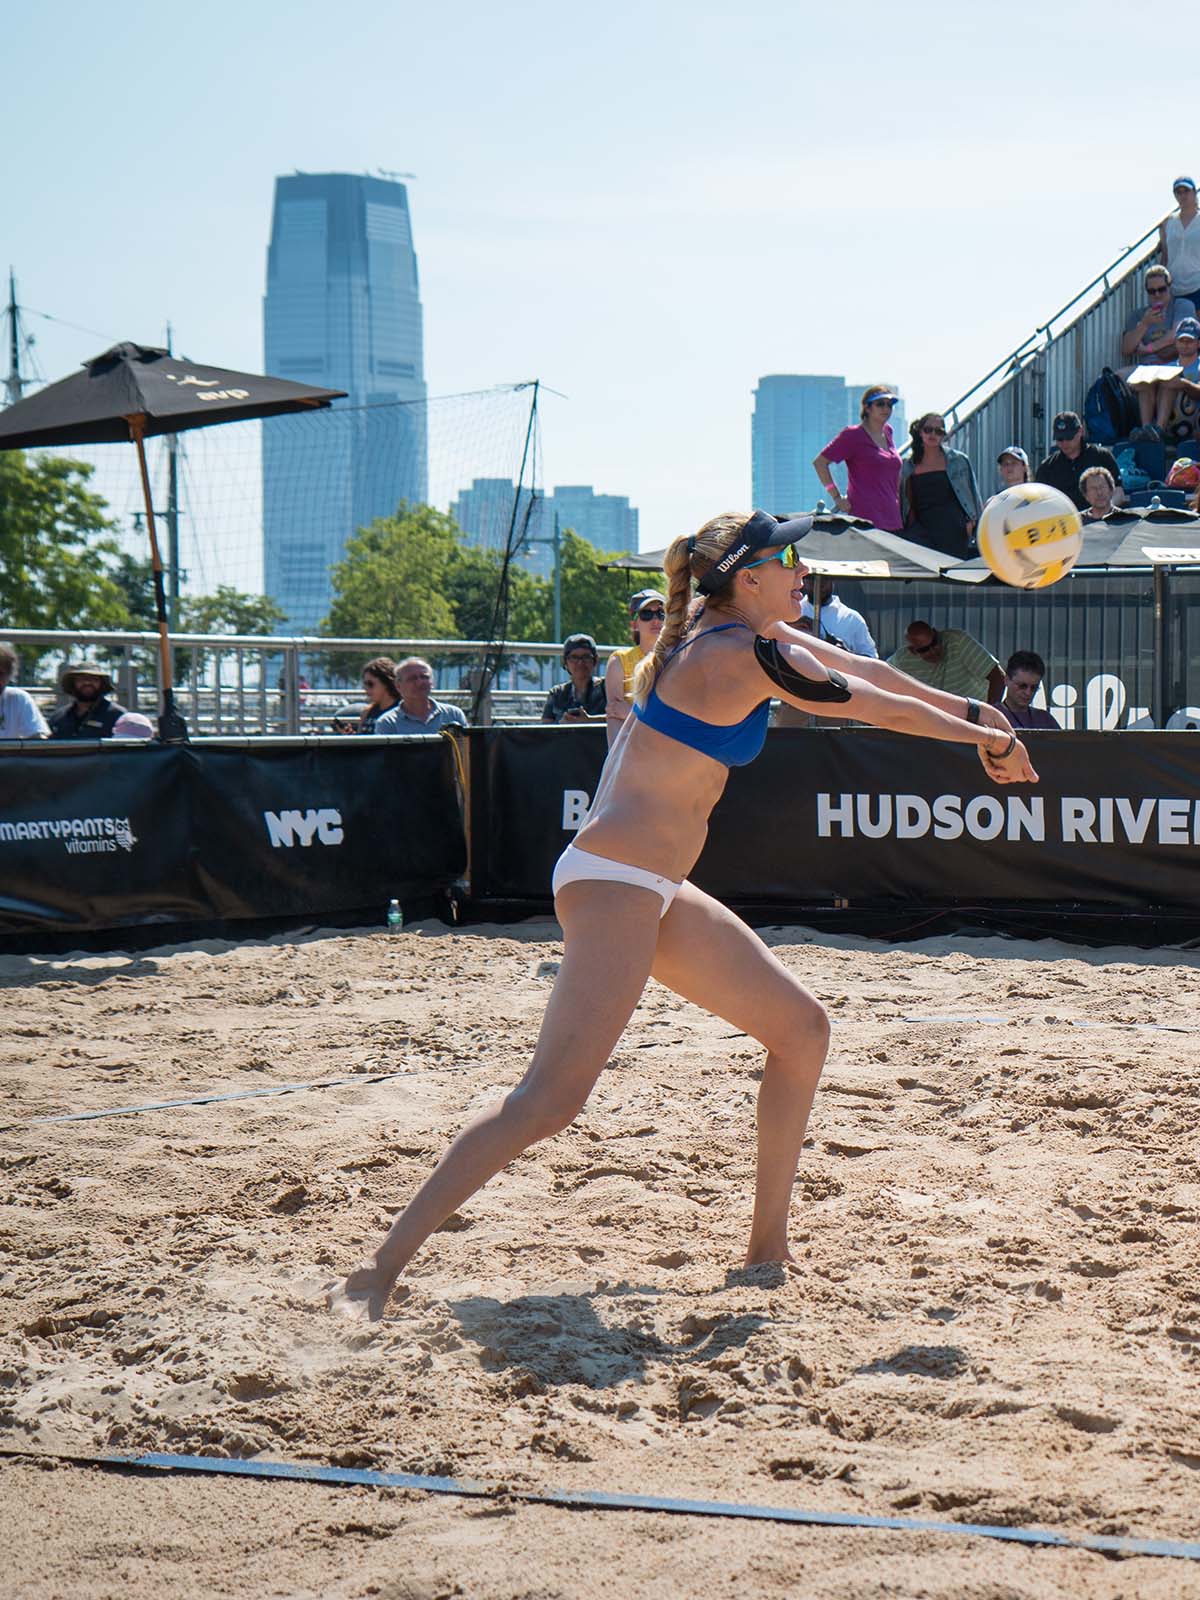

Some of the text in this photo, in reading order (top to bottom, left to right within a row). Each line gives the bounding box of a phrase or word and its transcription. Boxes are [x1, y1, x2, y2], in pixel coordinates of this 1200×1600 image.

[717, 543, 750, 573] Wilson
[264, 809, 344, 847] NYC
[817, 793, 1045, 842] HUDSON
[65, 837, 117, 853] vitamins
